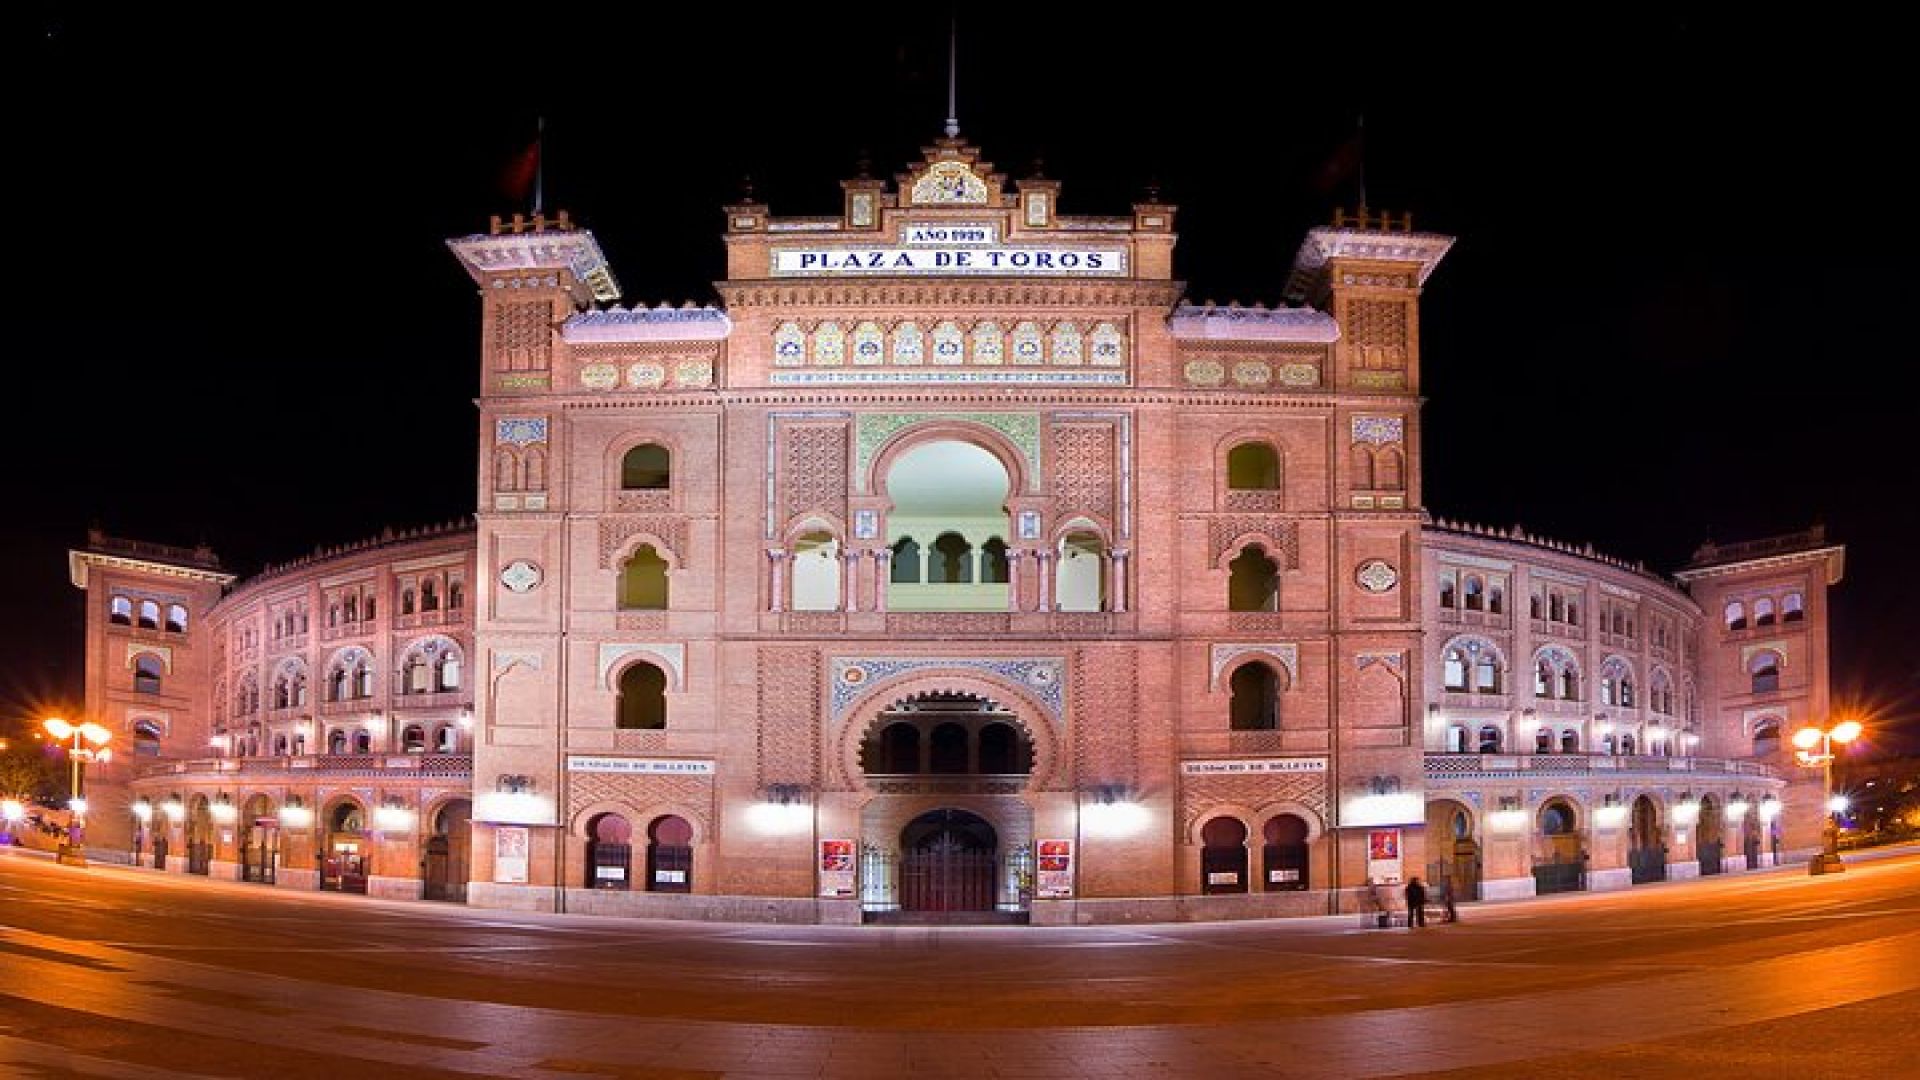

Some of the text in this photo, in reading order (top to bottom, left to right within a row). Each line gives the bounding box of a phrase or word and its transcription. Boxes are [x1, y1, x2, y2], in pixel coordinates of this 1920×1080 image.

[951, 230, 985, 241] 1929
[799, 251, 1103, 269] PLAZA DE TOROS
